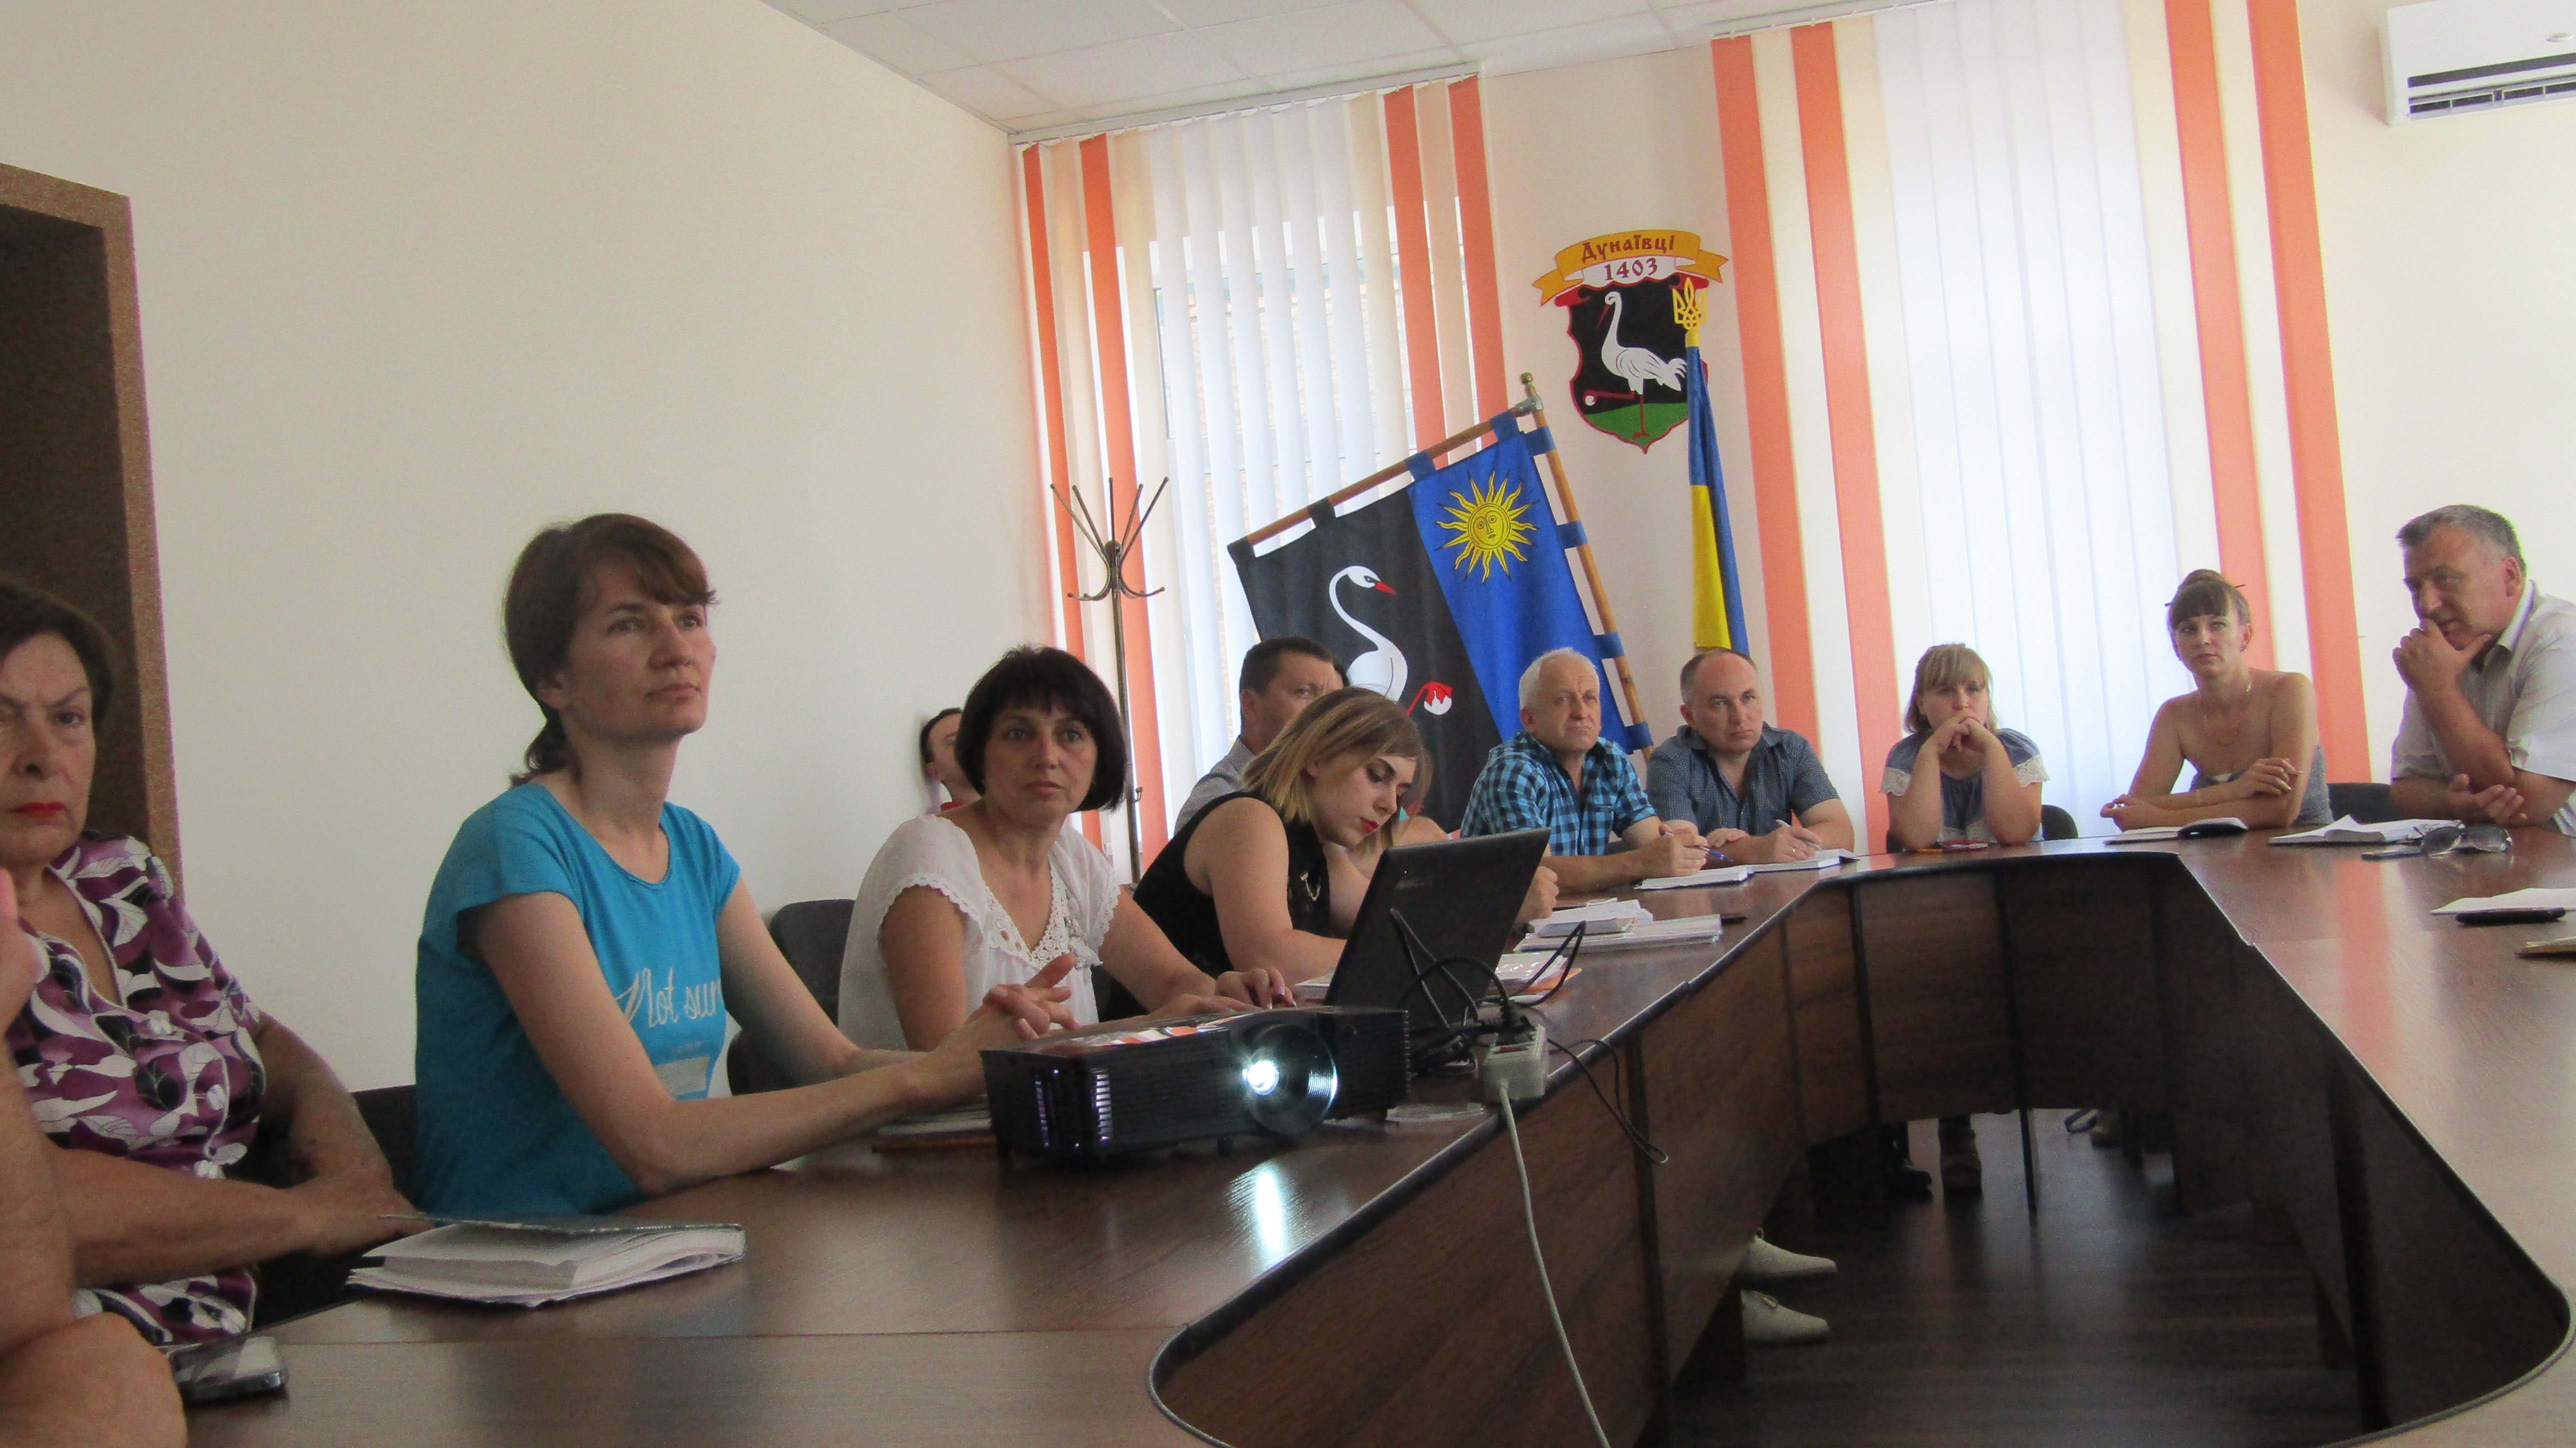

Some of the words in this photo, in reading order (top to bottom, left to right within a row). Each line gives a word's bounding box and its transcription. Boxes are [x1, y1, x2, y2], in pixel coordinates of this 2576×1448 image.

[1582, 234, 1674, 263] Дунаївці
[1604, 258, 1658, 280] 1403
[616, 968, 679, 1027] Not
